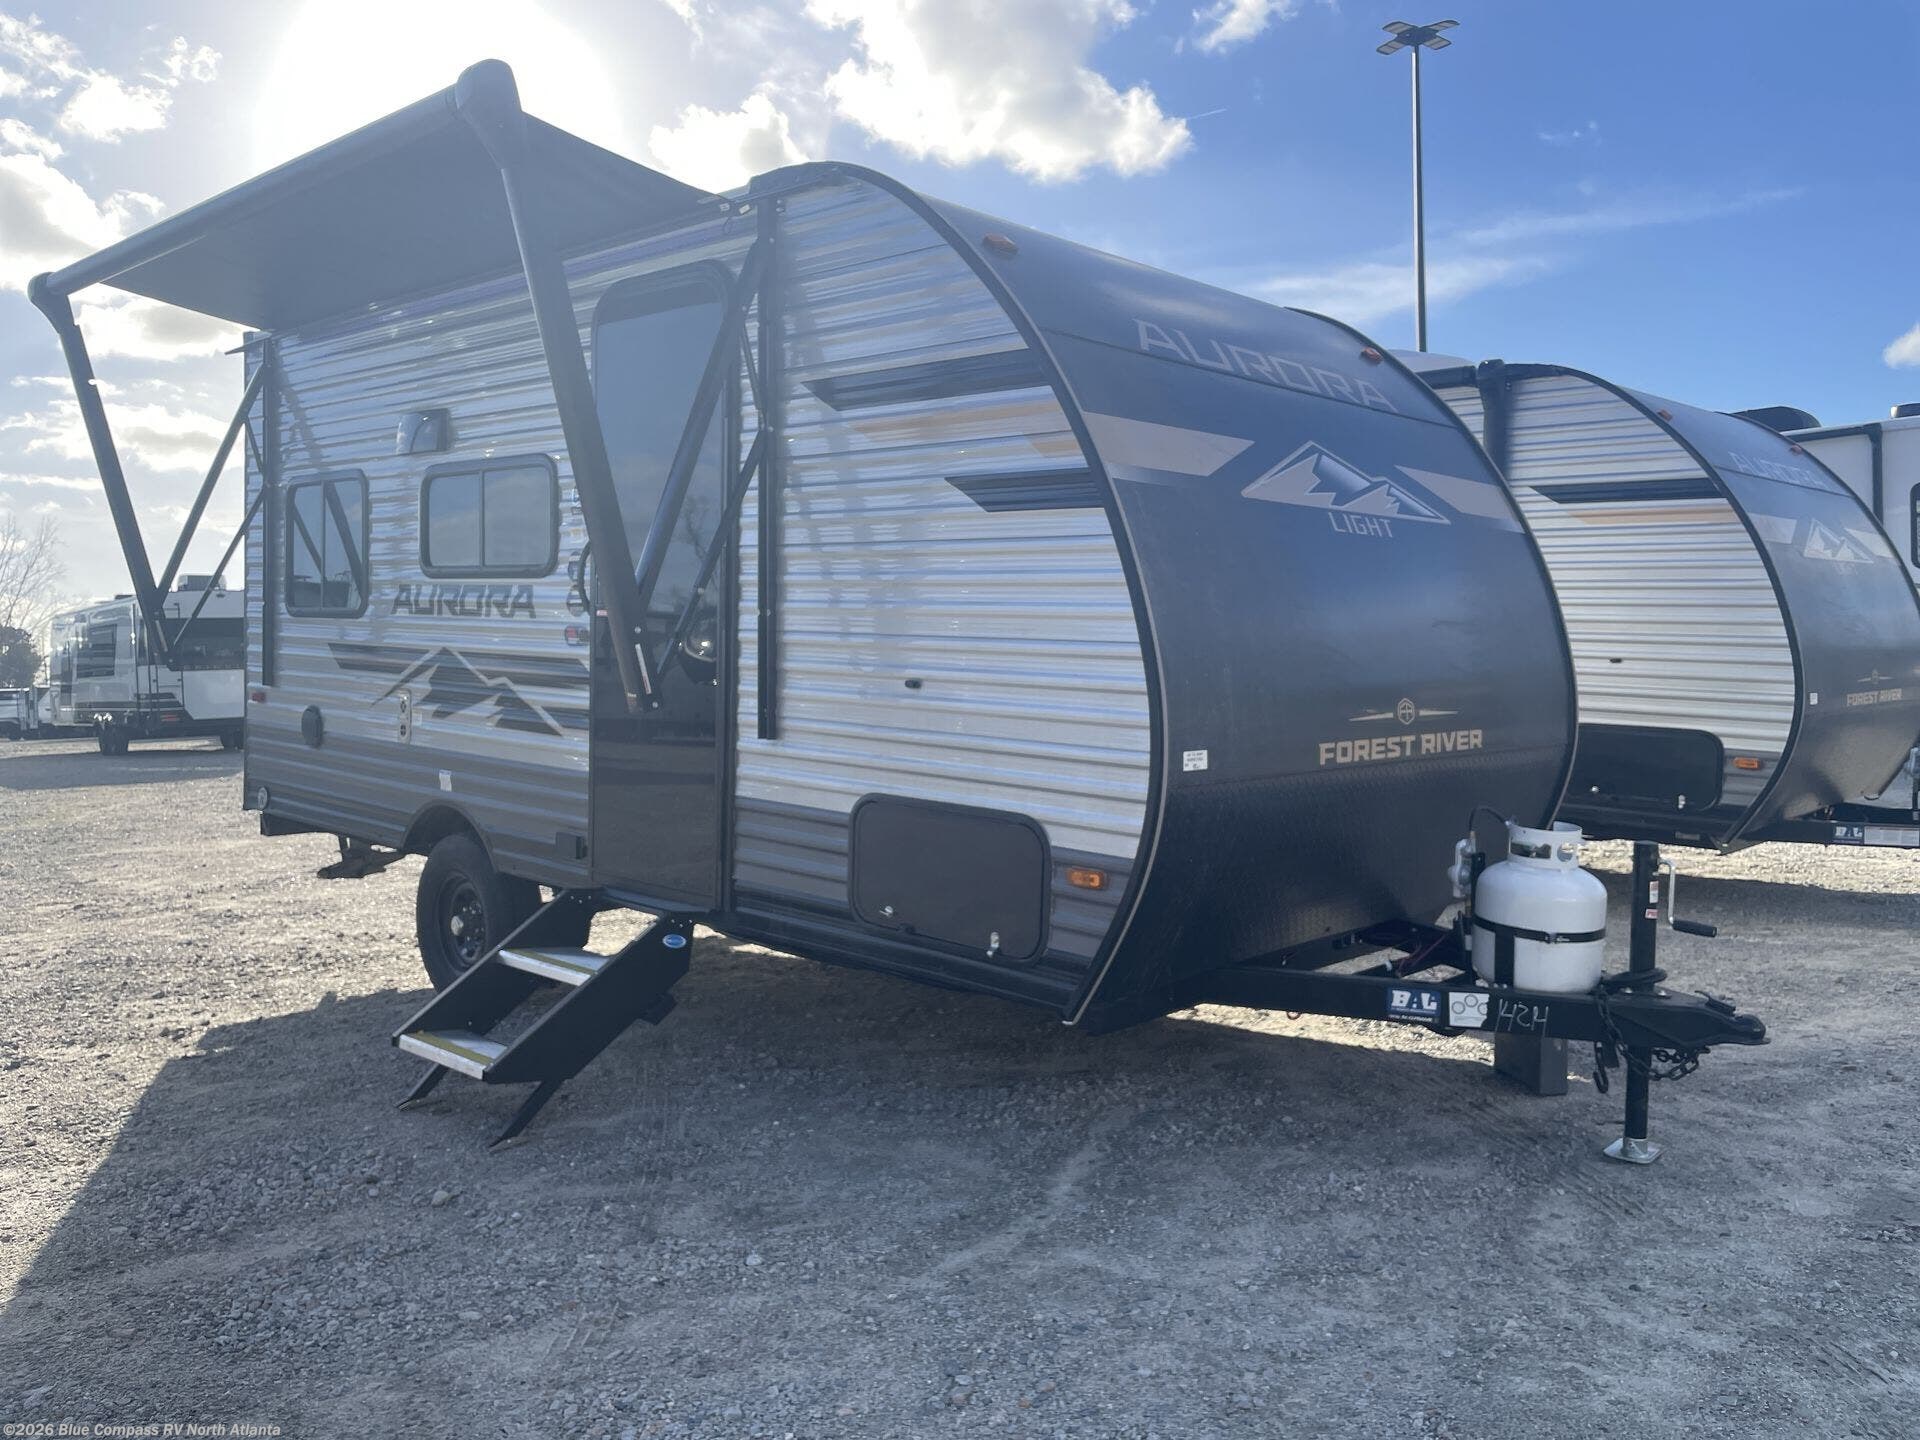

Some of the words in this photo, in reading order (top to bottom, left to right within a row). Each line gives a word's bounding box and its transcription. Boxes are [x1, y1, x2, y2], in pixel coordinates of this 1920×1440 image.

[1132, 317, 1399, 415] AURORA
[1328, 511, 1394, 539] LIGHT
[390, 583, 537, 619] AURORA
[1318, 735, 1417, 766] FOREST
[1420, 728, 1484, 755] RIVER
[1391, 989, 1438, 1011] BAL
